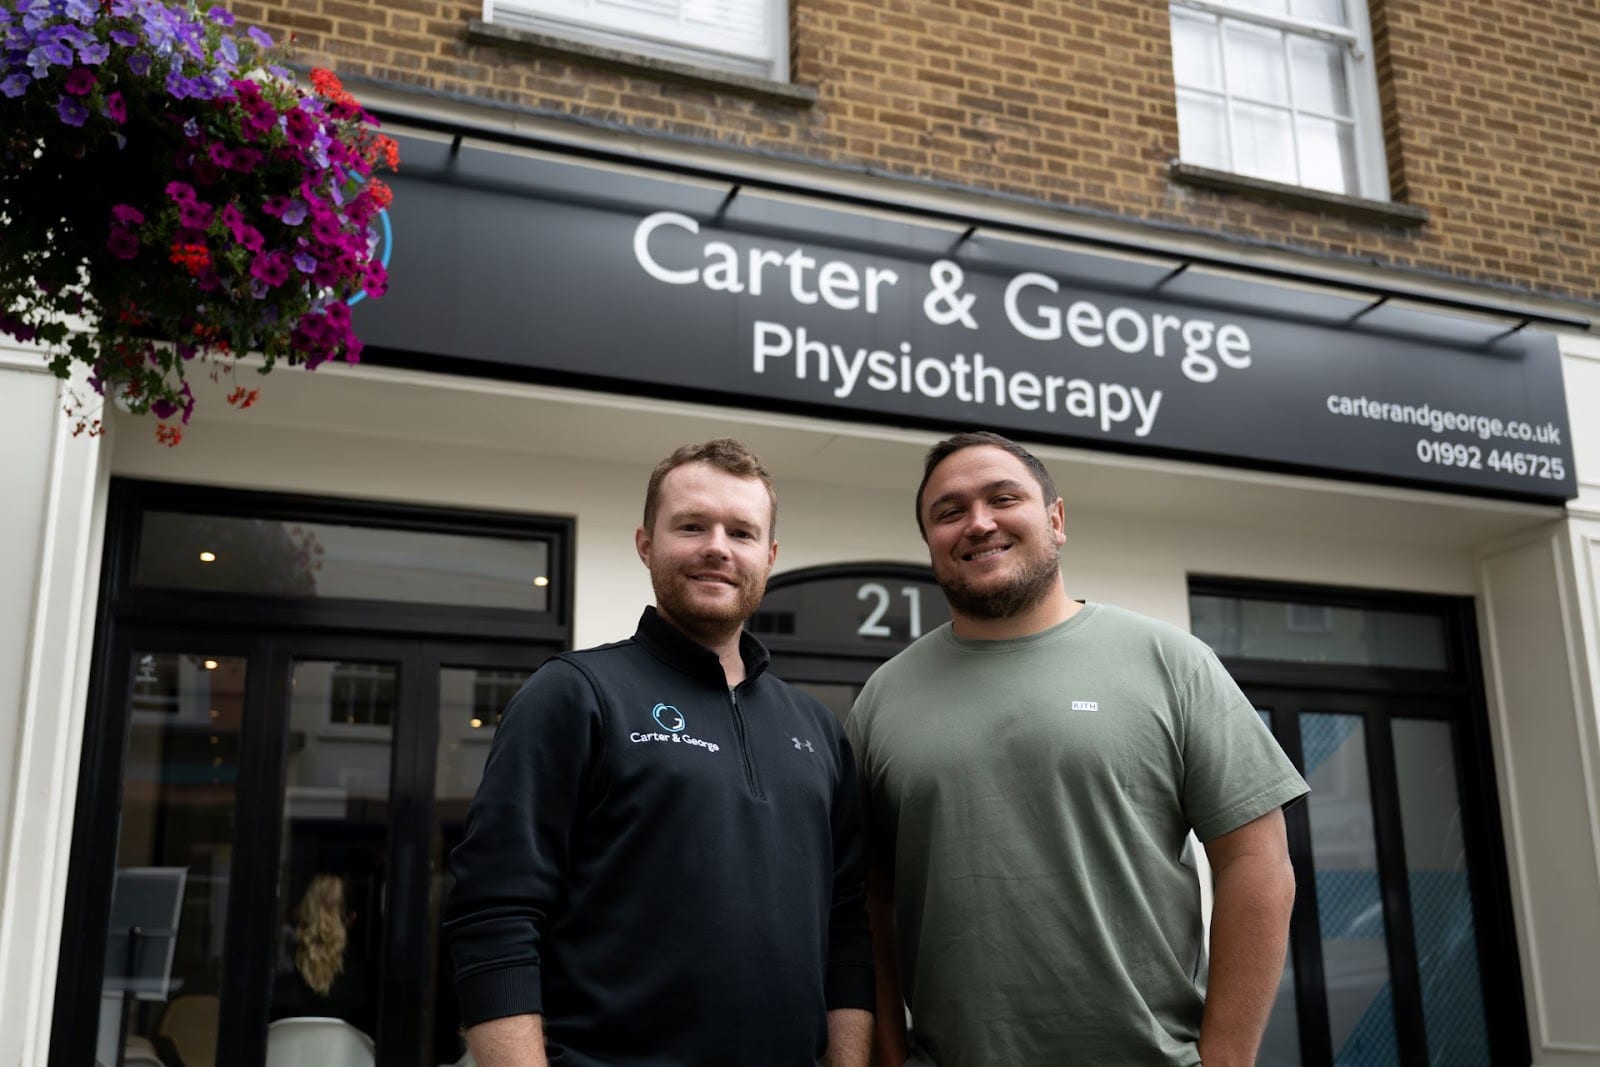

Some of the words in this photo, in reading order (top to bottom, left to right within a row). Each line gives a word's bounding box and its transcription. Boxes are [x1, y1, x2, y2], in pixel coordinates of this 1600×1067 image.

[633, 211, 898, 314] Carter
[923, 259, 979, 330] &
[1003, 271, 1253, 383] George
[752, 320, 1163, 437] Physiotherapy
[1326, 394, 1561, 446] carterandgeorge.co.uk
[1416, 438, 1483, 470] 01992
[1486, 449, 1566, 481] 446725
[856, 582, 922, 639] 21
[1073, 702, 1096, 710] KITH
[630, 732, 670, 743] Carter
[671, 733, 681, 743] &
[682, 734, 720, 753] George
